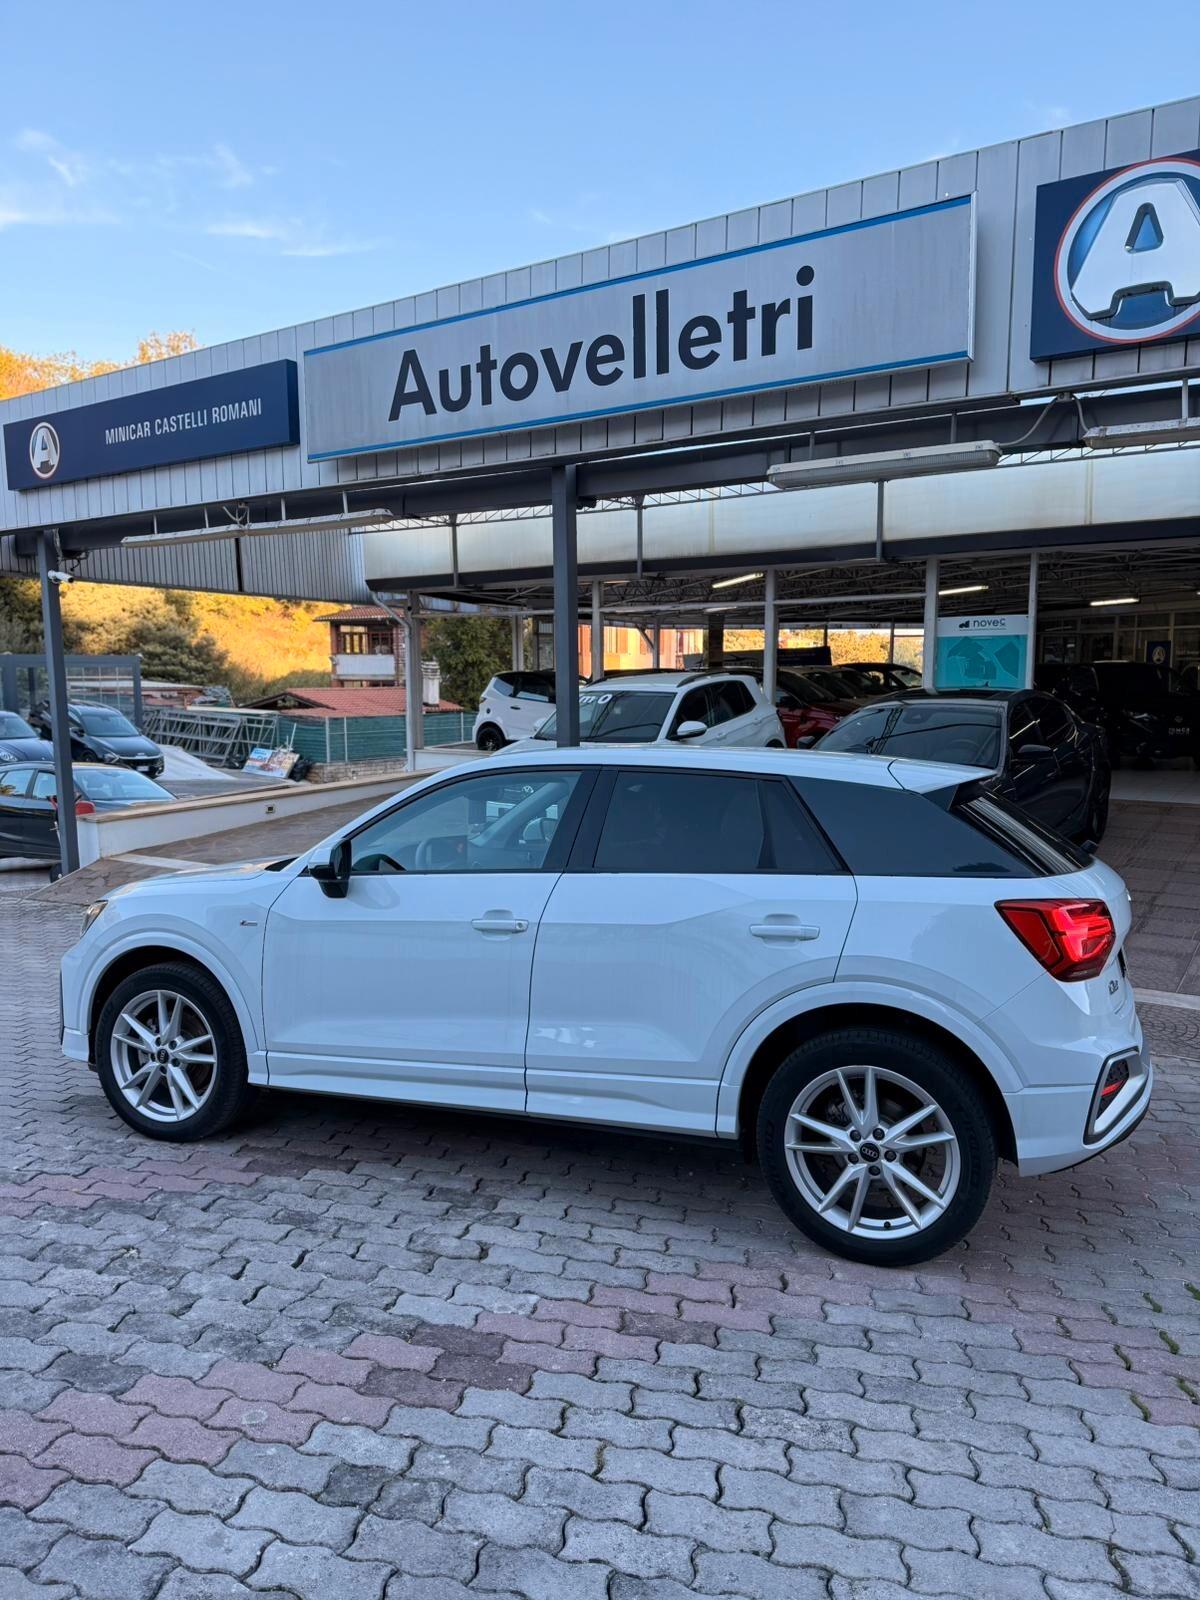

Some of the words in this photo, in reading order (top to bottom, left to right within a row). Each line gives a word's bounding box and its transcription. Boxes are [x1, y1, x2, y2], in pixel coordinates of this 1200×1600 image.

[388, 265, 815, 422] Autovelletri
[105, 421, 151, 445] MINICAR
[155, 409, 208, 434] CASTELLI
[212, 397, 262, 423] ROMANI
